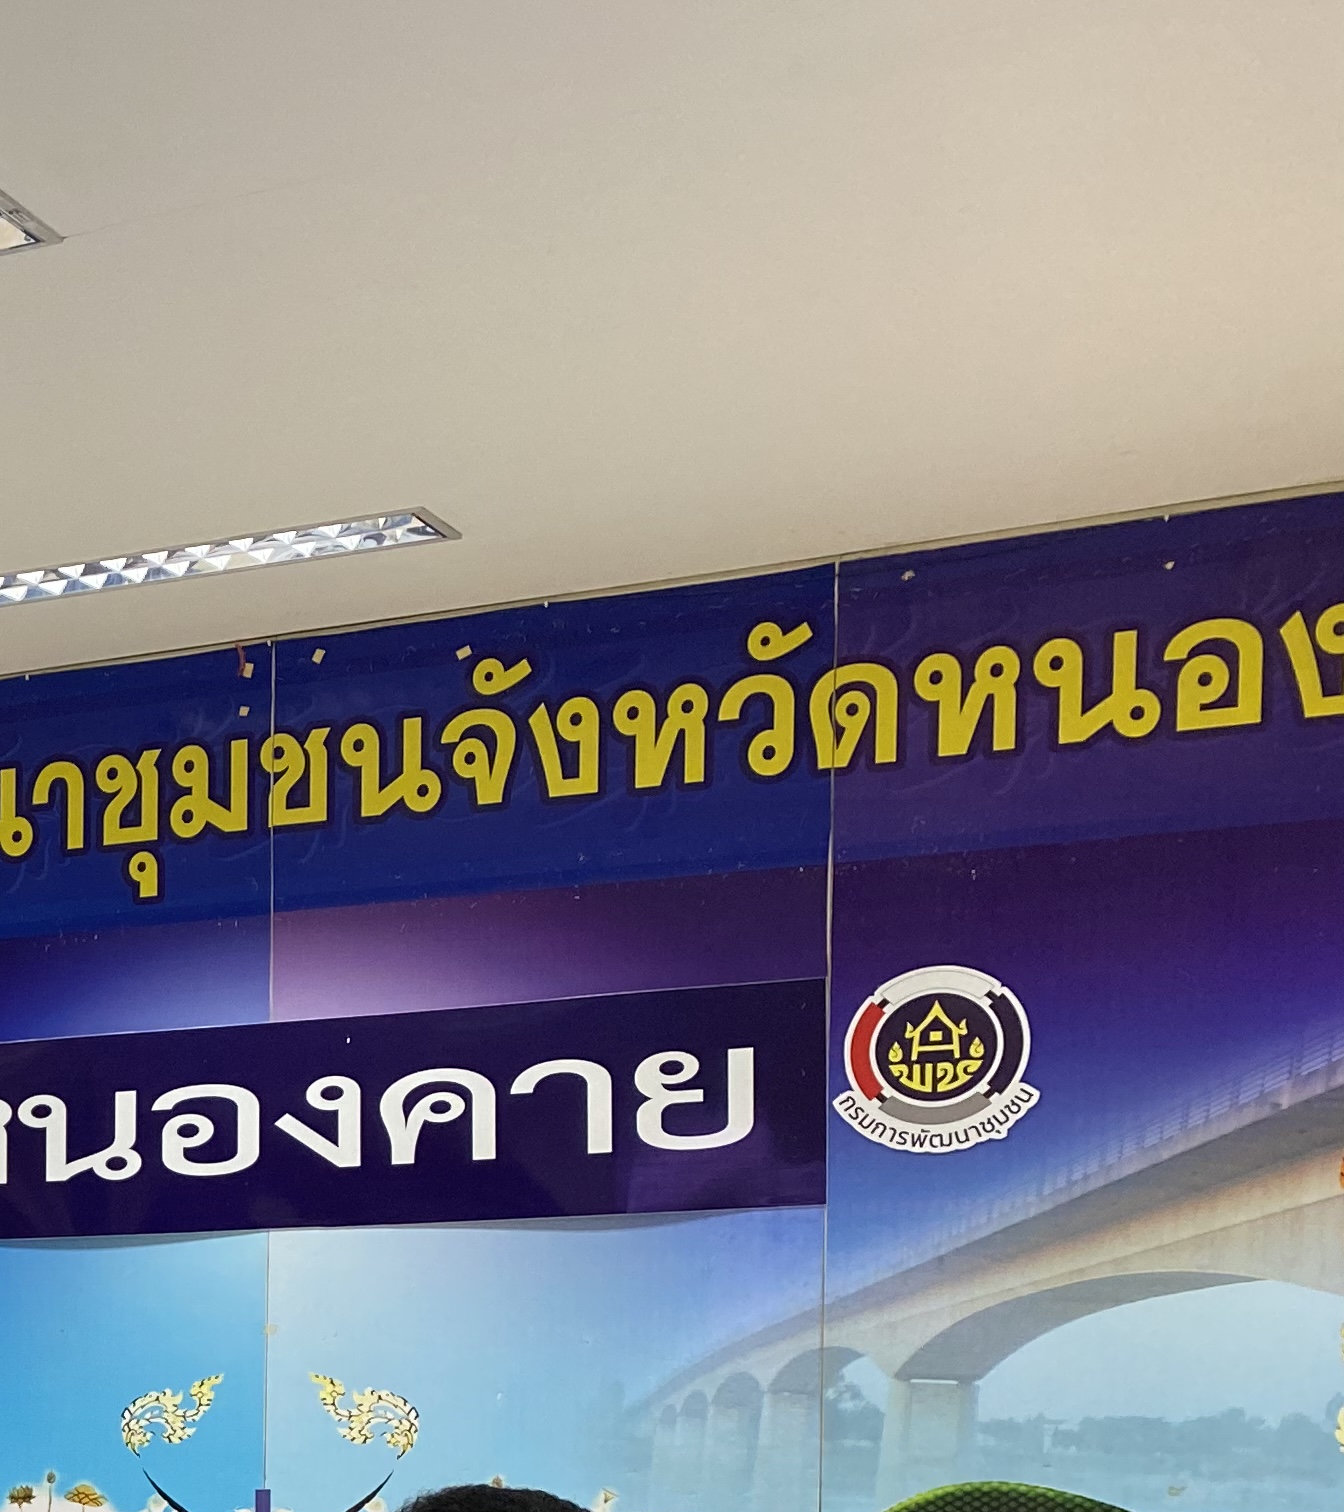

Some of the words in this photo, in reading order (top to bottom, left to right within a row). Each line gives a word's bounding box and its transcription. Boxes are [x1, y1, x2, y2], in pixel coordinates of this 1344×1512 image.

[838, 1087, 1035, 1149] กรมการพัฒนาชุมชน
